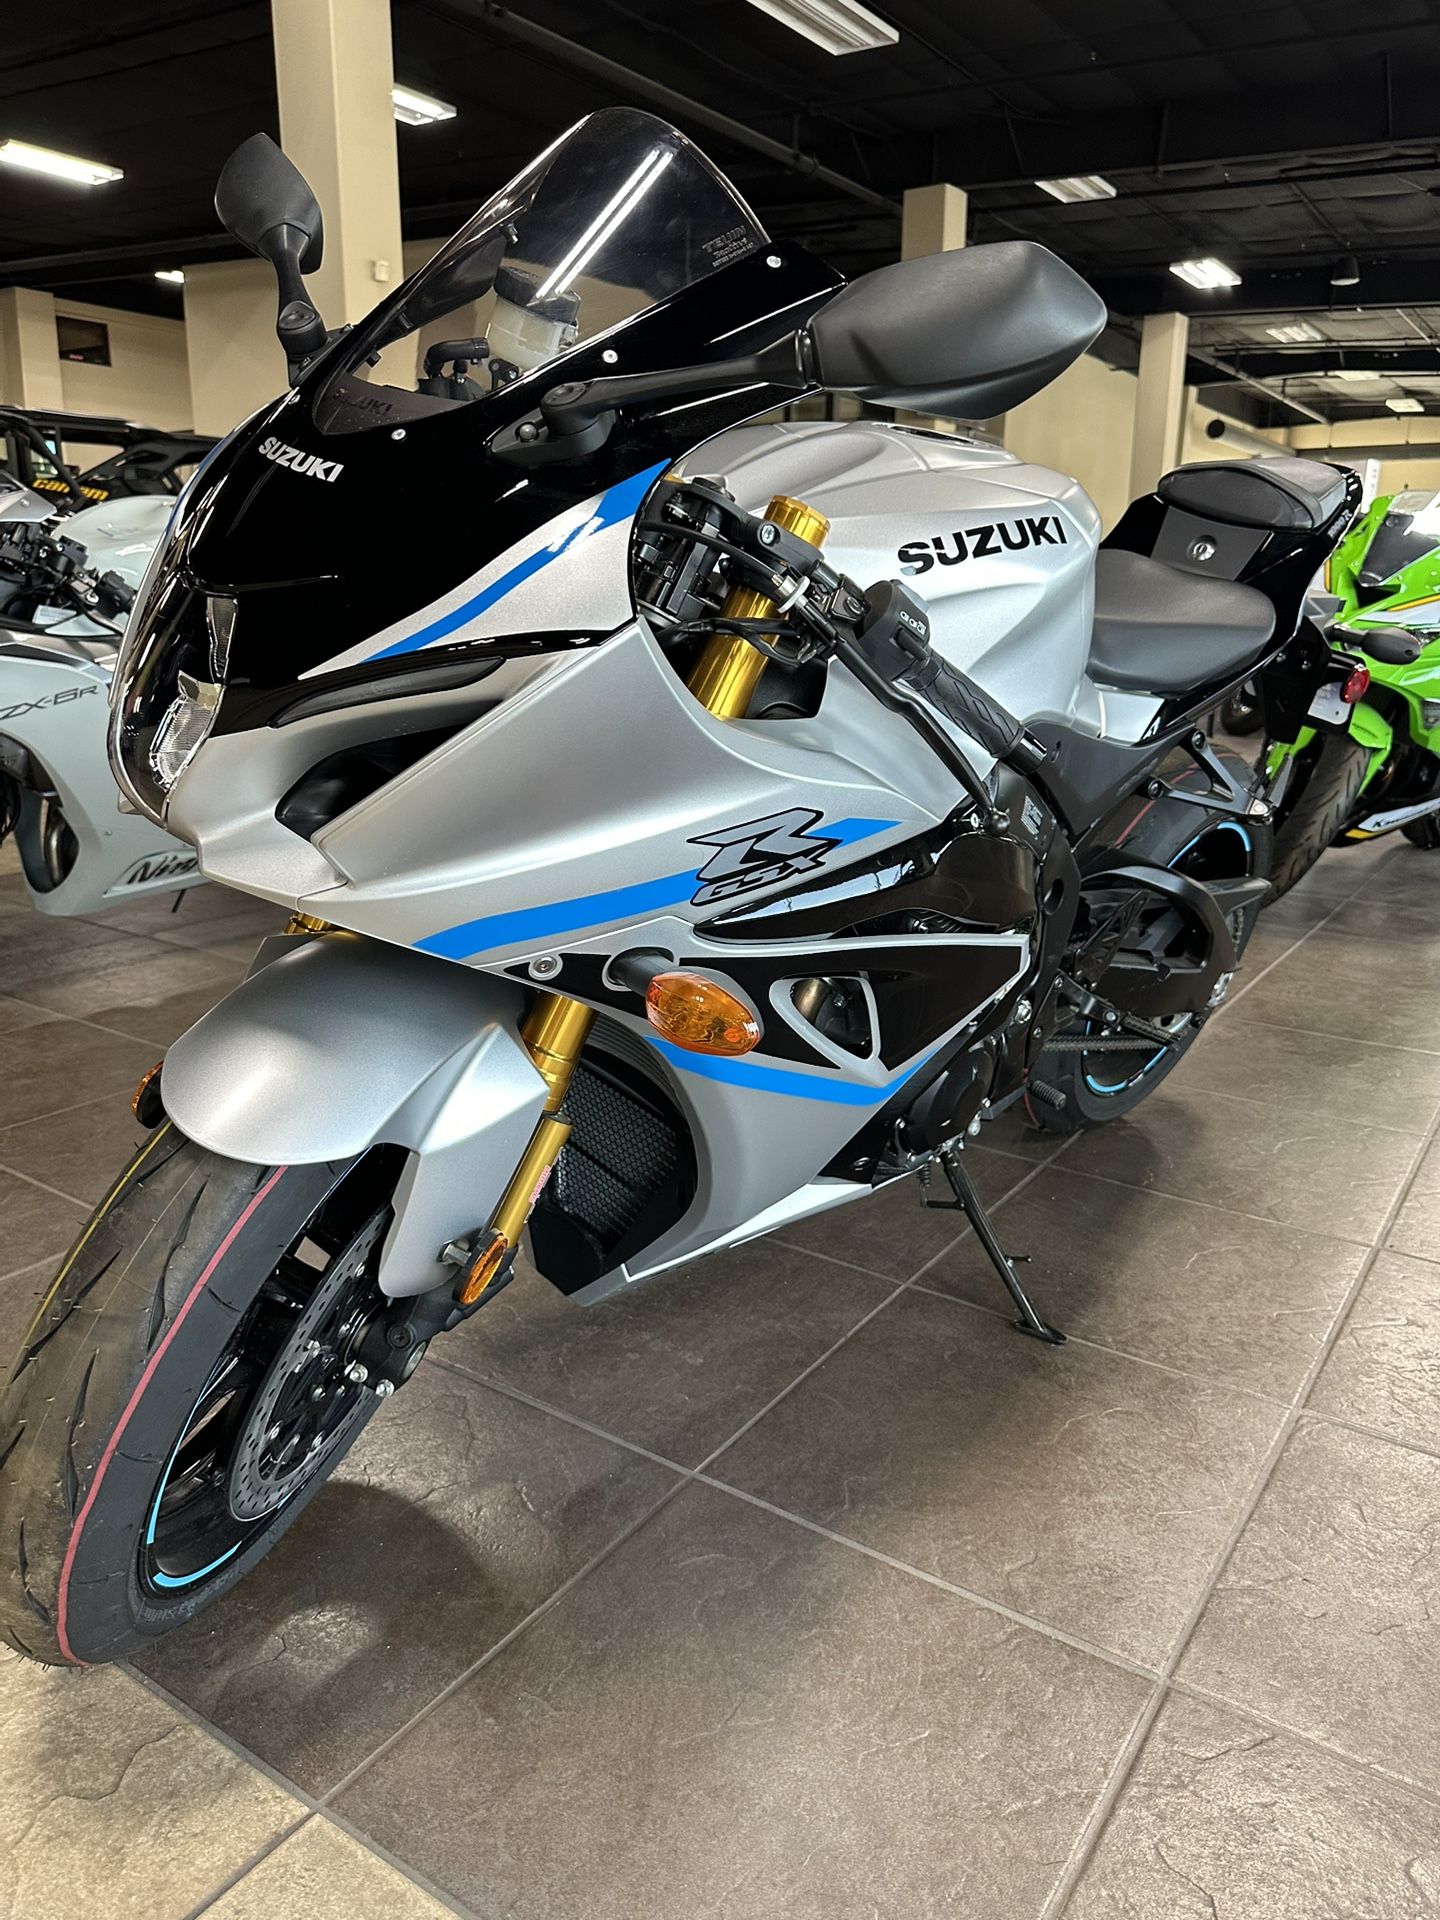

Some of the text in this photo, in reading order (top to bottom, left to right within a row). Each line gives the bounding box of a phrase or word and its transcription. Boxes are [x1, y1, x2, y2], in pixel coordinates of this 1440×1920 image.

[258, 436, 345, 483] SUZUKI
[32, 478, 110, 501] canam
[897, 516, 1068, 577] SUZUKI
[0, 685, 98, 721] ZX-6R
[127, 855, 199, 885] Nin
